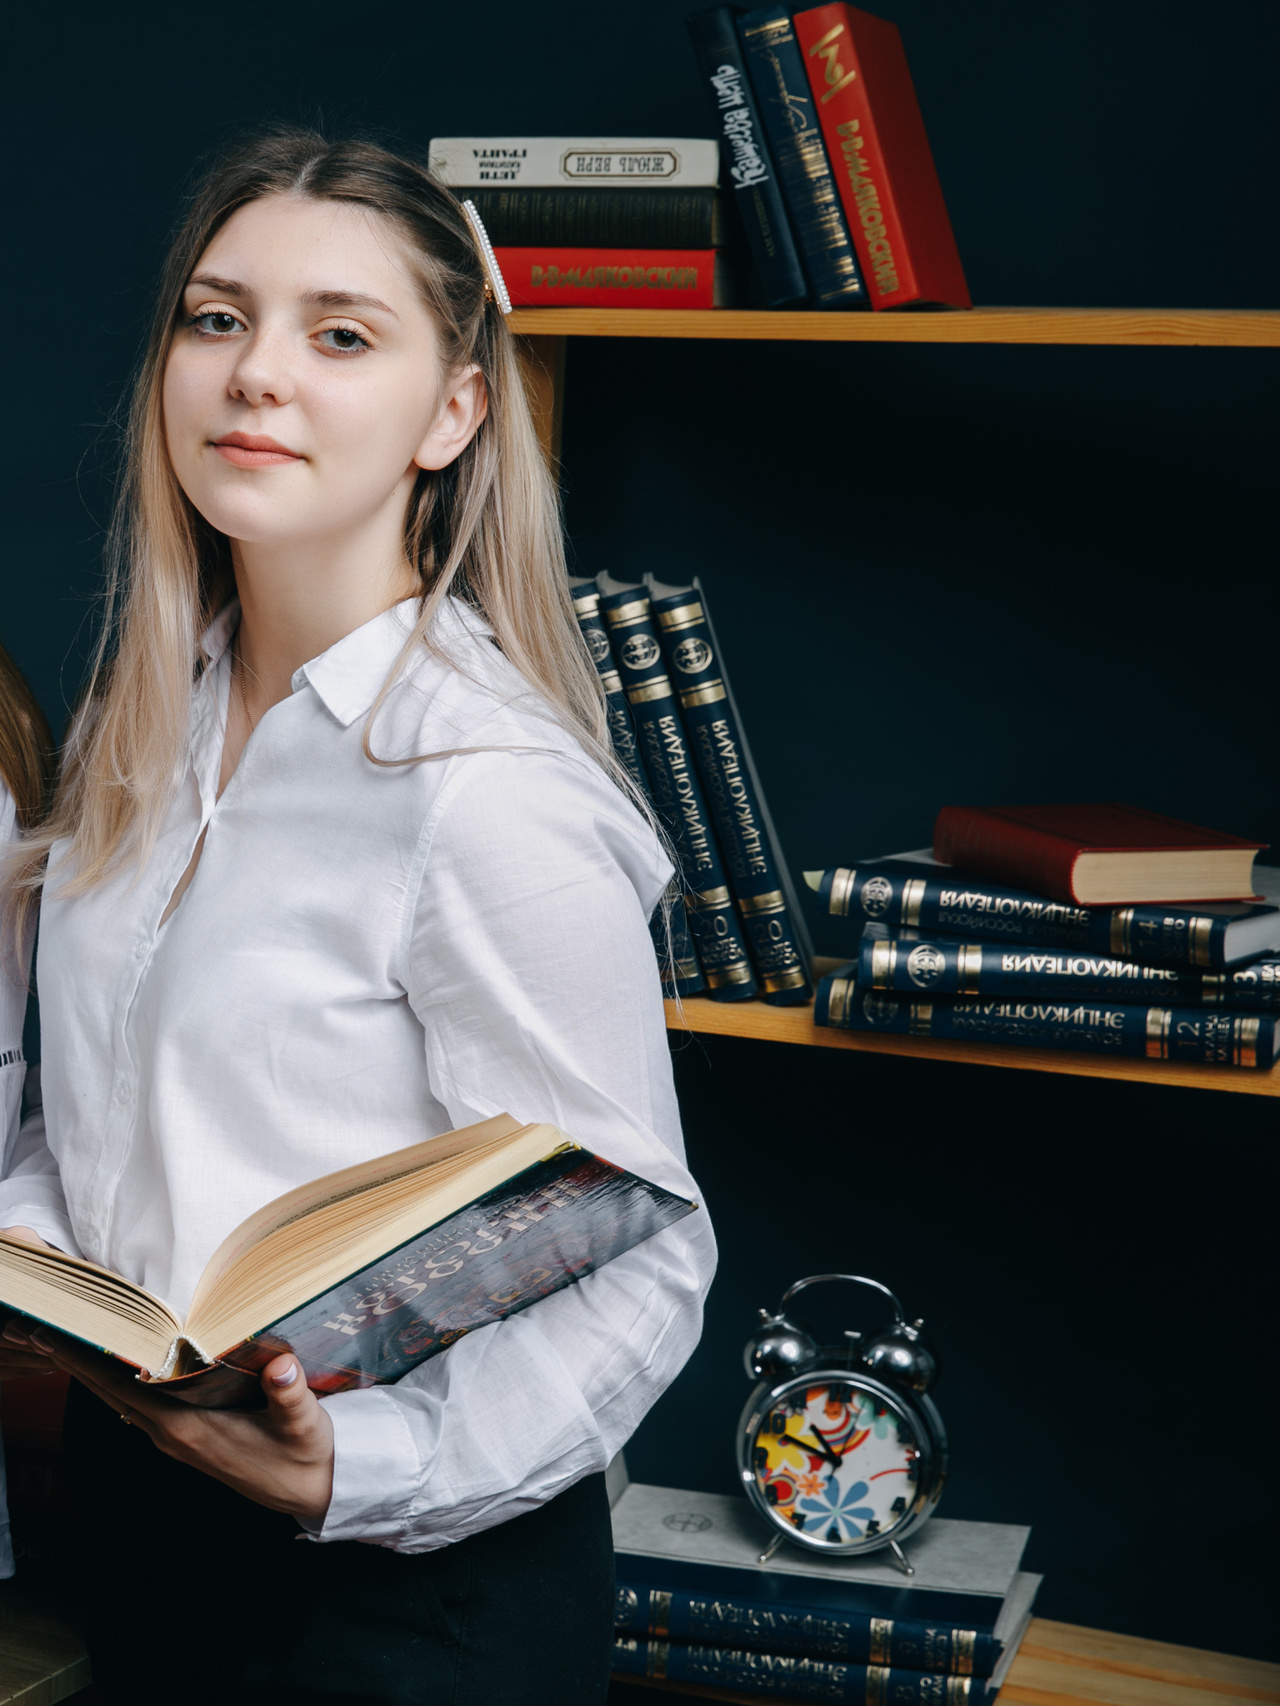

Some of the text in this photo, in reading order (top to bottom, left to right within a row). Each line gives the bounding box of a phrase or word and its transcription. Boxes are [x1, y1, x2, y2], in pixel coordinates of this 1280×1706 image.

[472, 149, 527, 159] ГРАНТА
[575, 156, 665, 173] ЖЮЛЬ ВЕРН
[479, 170, 519, 180] ДЕТИ
[658, 715, 713, 872] ЭНЦИКЛОПЕДИЯ
[712, 719, 767, 876] ЭНЦИКЛОПЕДИЯ
[939, 890, 1091, 926] ЭНЦИКЛОПЕДИЯ
[1001, 953, 1179, 982] ЭНЦИКЛОПЕДИЯ
[953, 1003, 1125, 1029] ЭНЦИКЛОПЕДИЯ
[1176, 1021, 1201, 1048] 12
